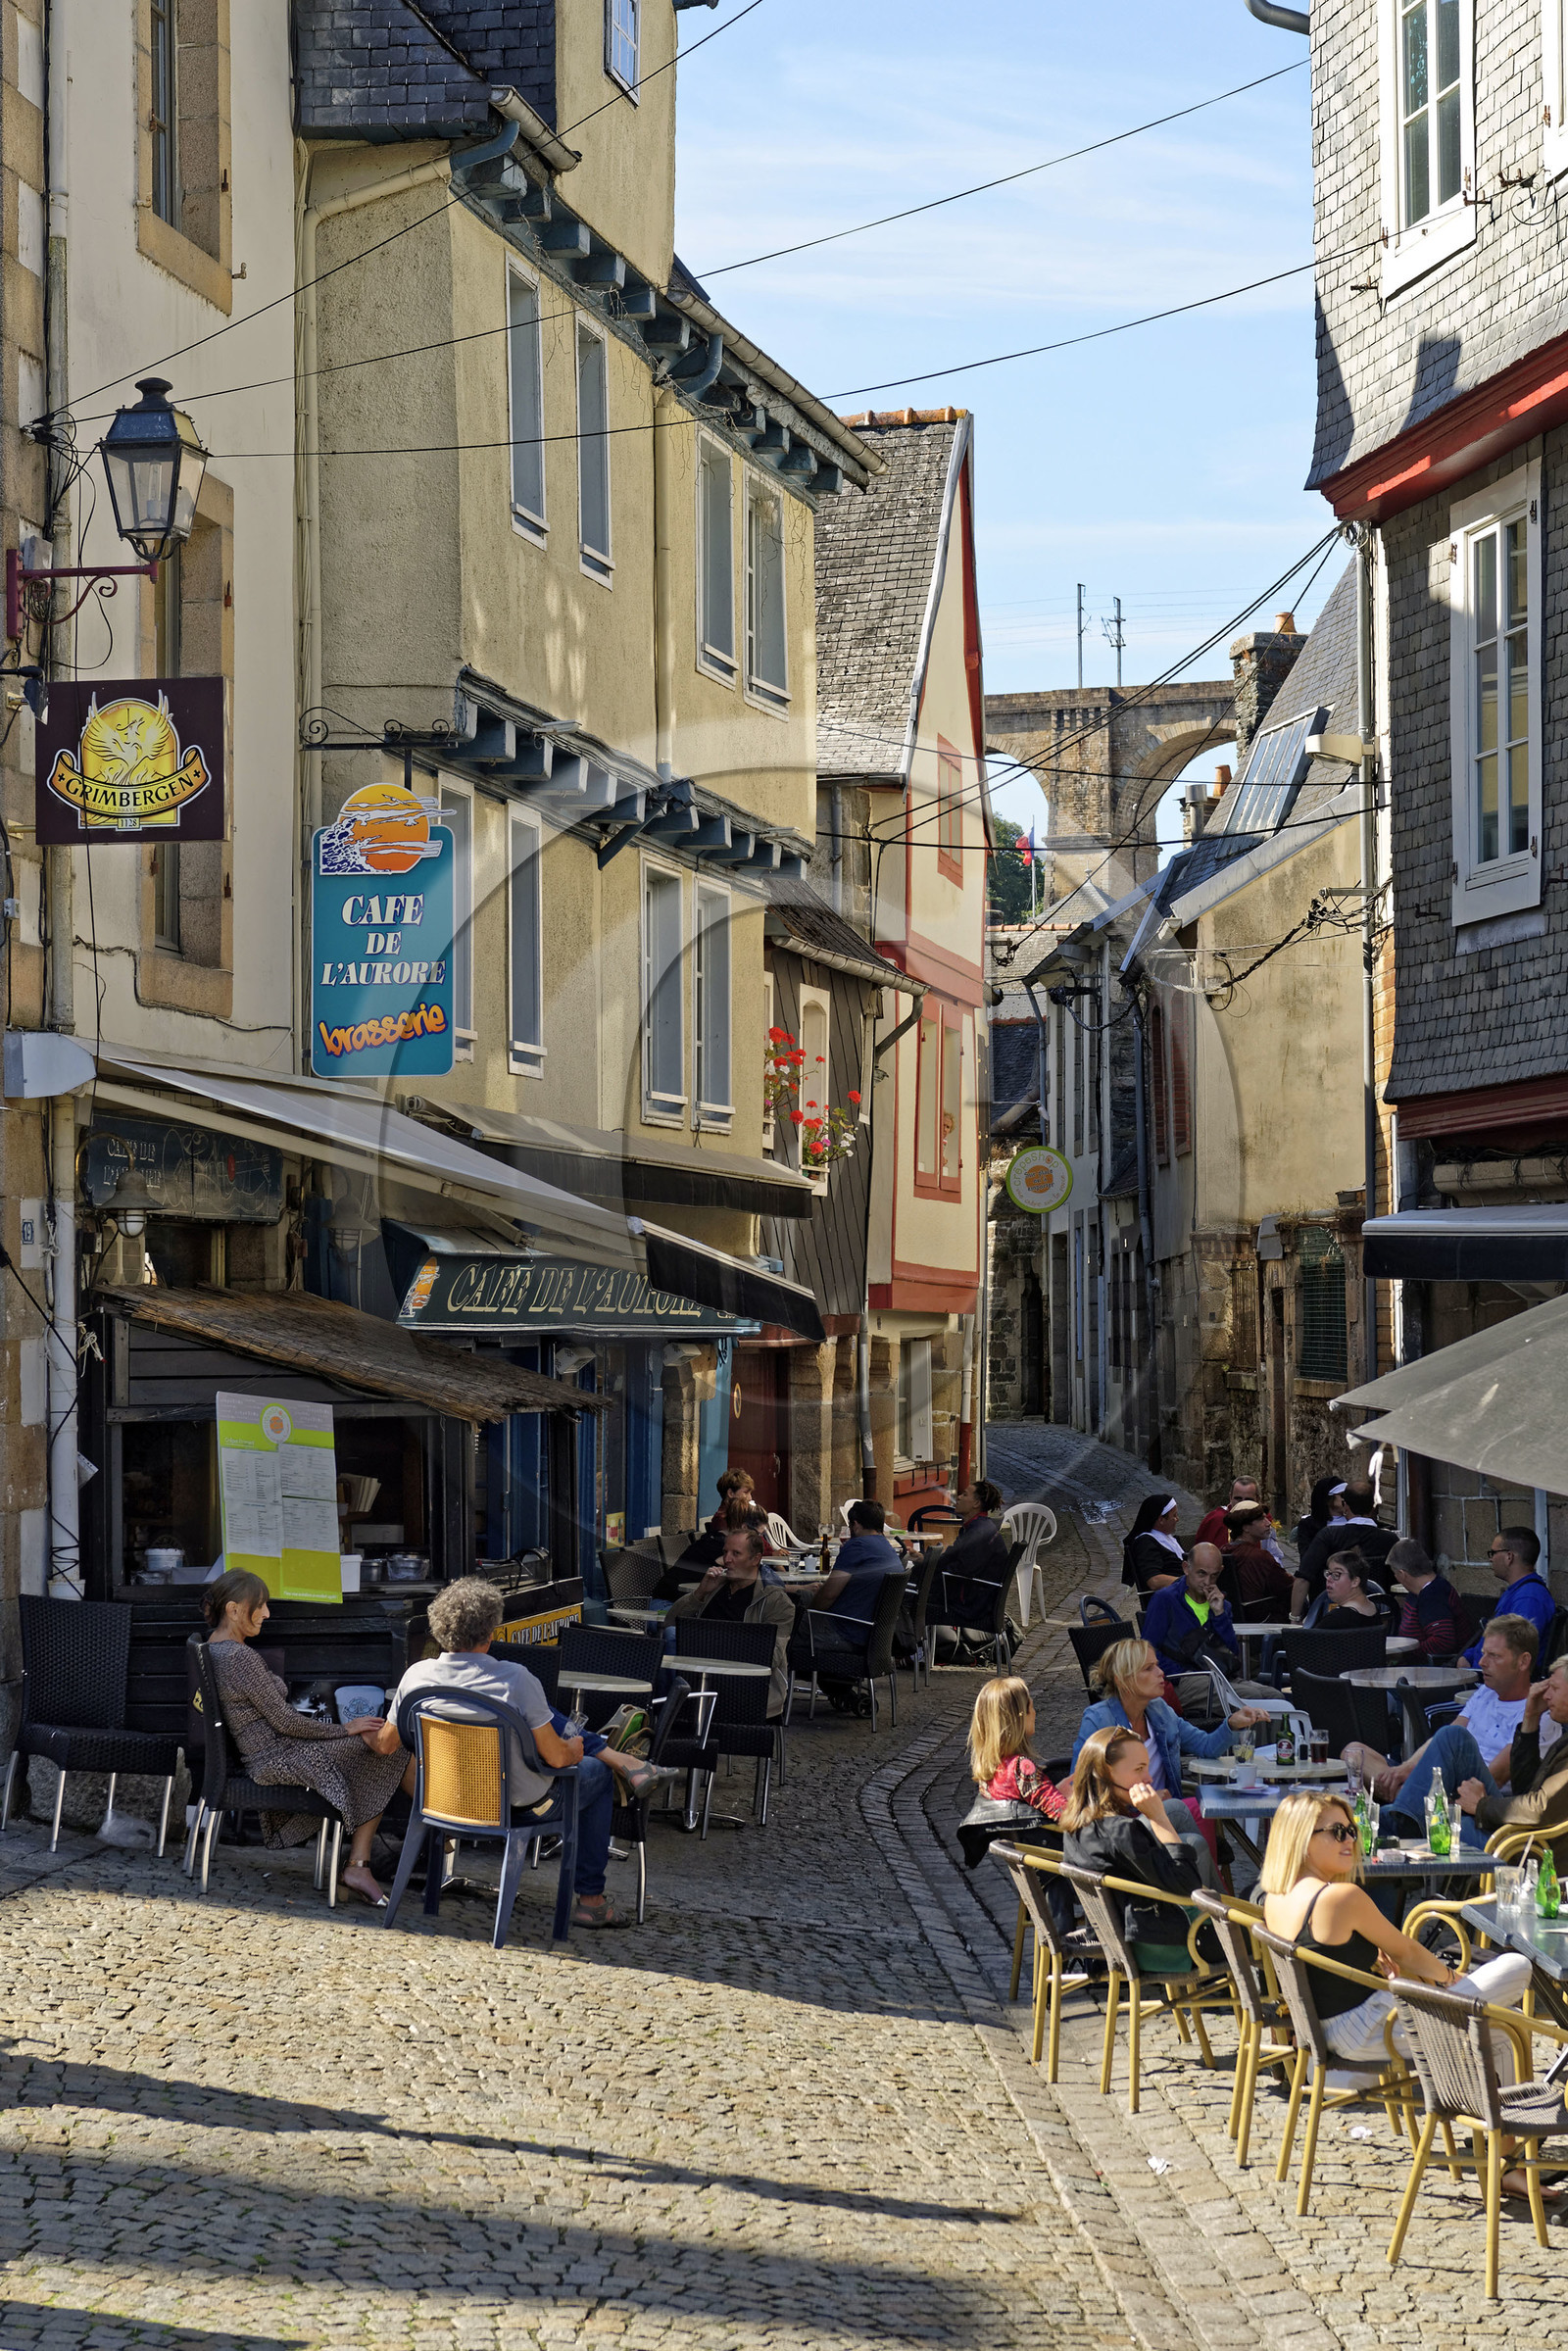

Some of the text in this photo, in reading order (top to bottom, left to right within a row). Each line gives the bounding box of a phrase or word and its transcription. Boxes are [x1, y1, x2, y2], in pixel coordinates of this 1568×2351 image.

[66, 772, 194, 807] GRIMBERGEN
[120, 818, 137, 828] 1128
[342, 893, 424, 927] CAFE
[364, 931, 402, 956] DE
[319, 960, 447, 987] L'AURORE
[318, 1003, 448, 1057] brasserie
[24, 1223, 32, 1242] 19
[447, 1262, 535, 1315] CAFE
[528, 1264, 576, 1315] DE
[511, 1627, 530, 1644] CAFE
[531, 1624, 542, 1643] DE
